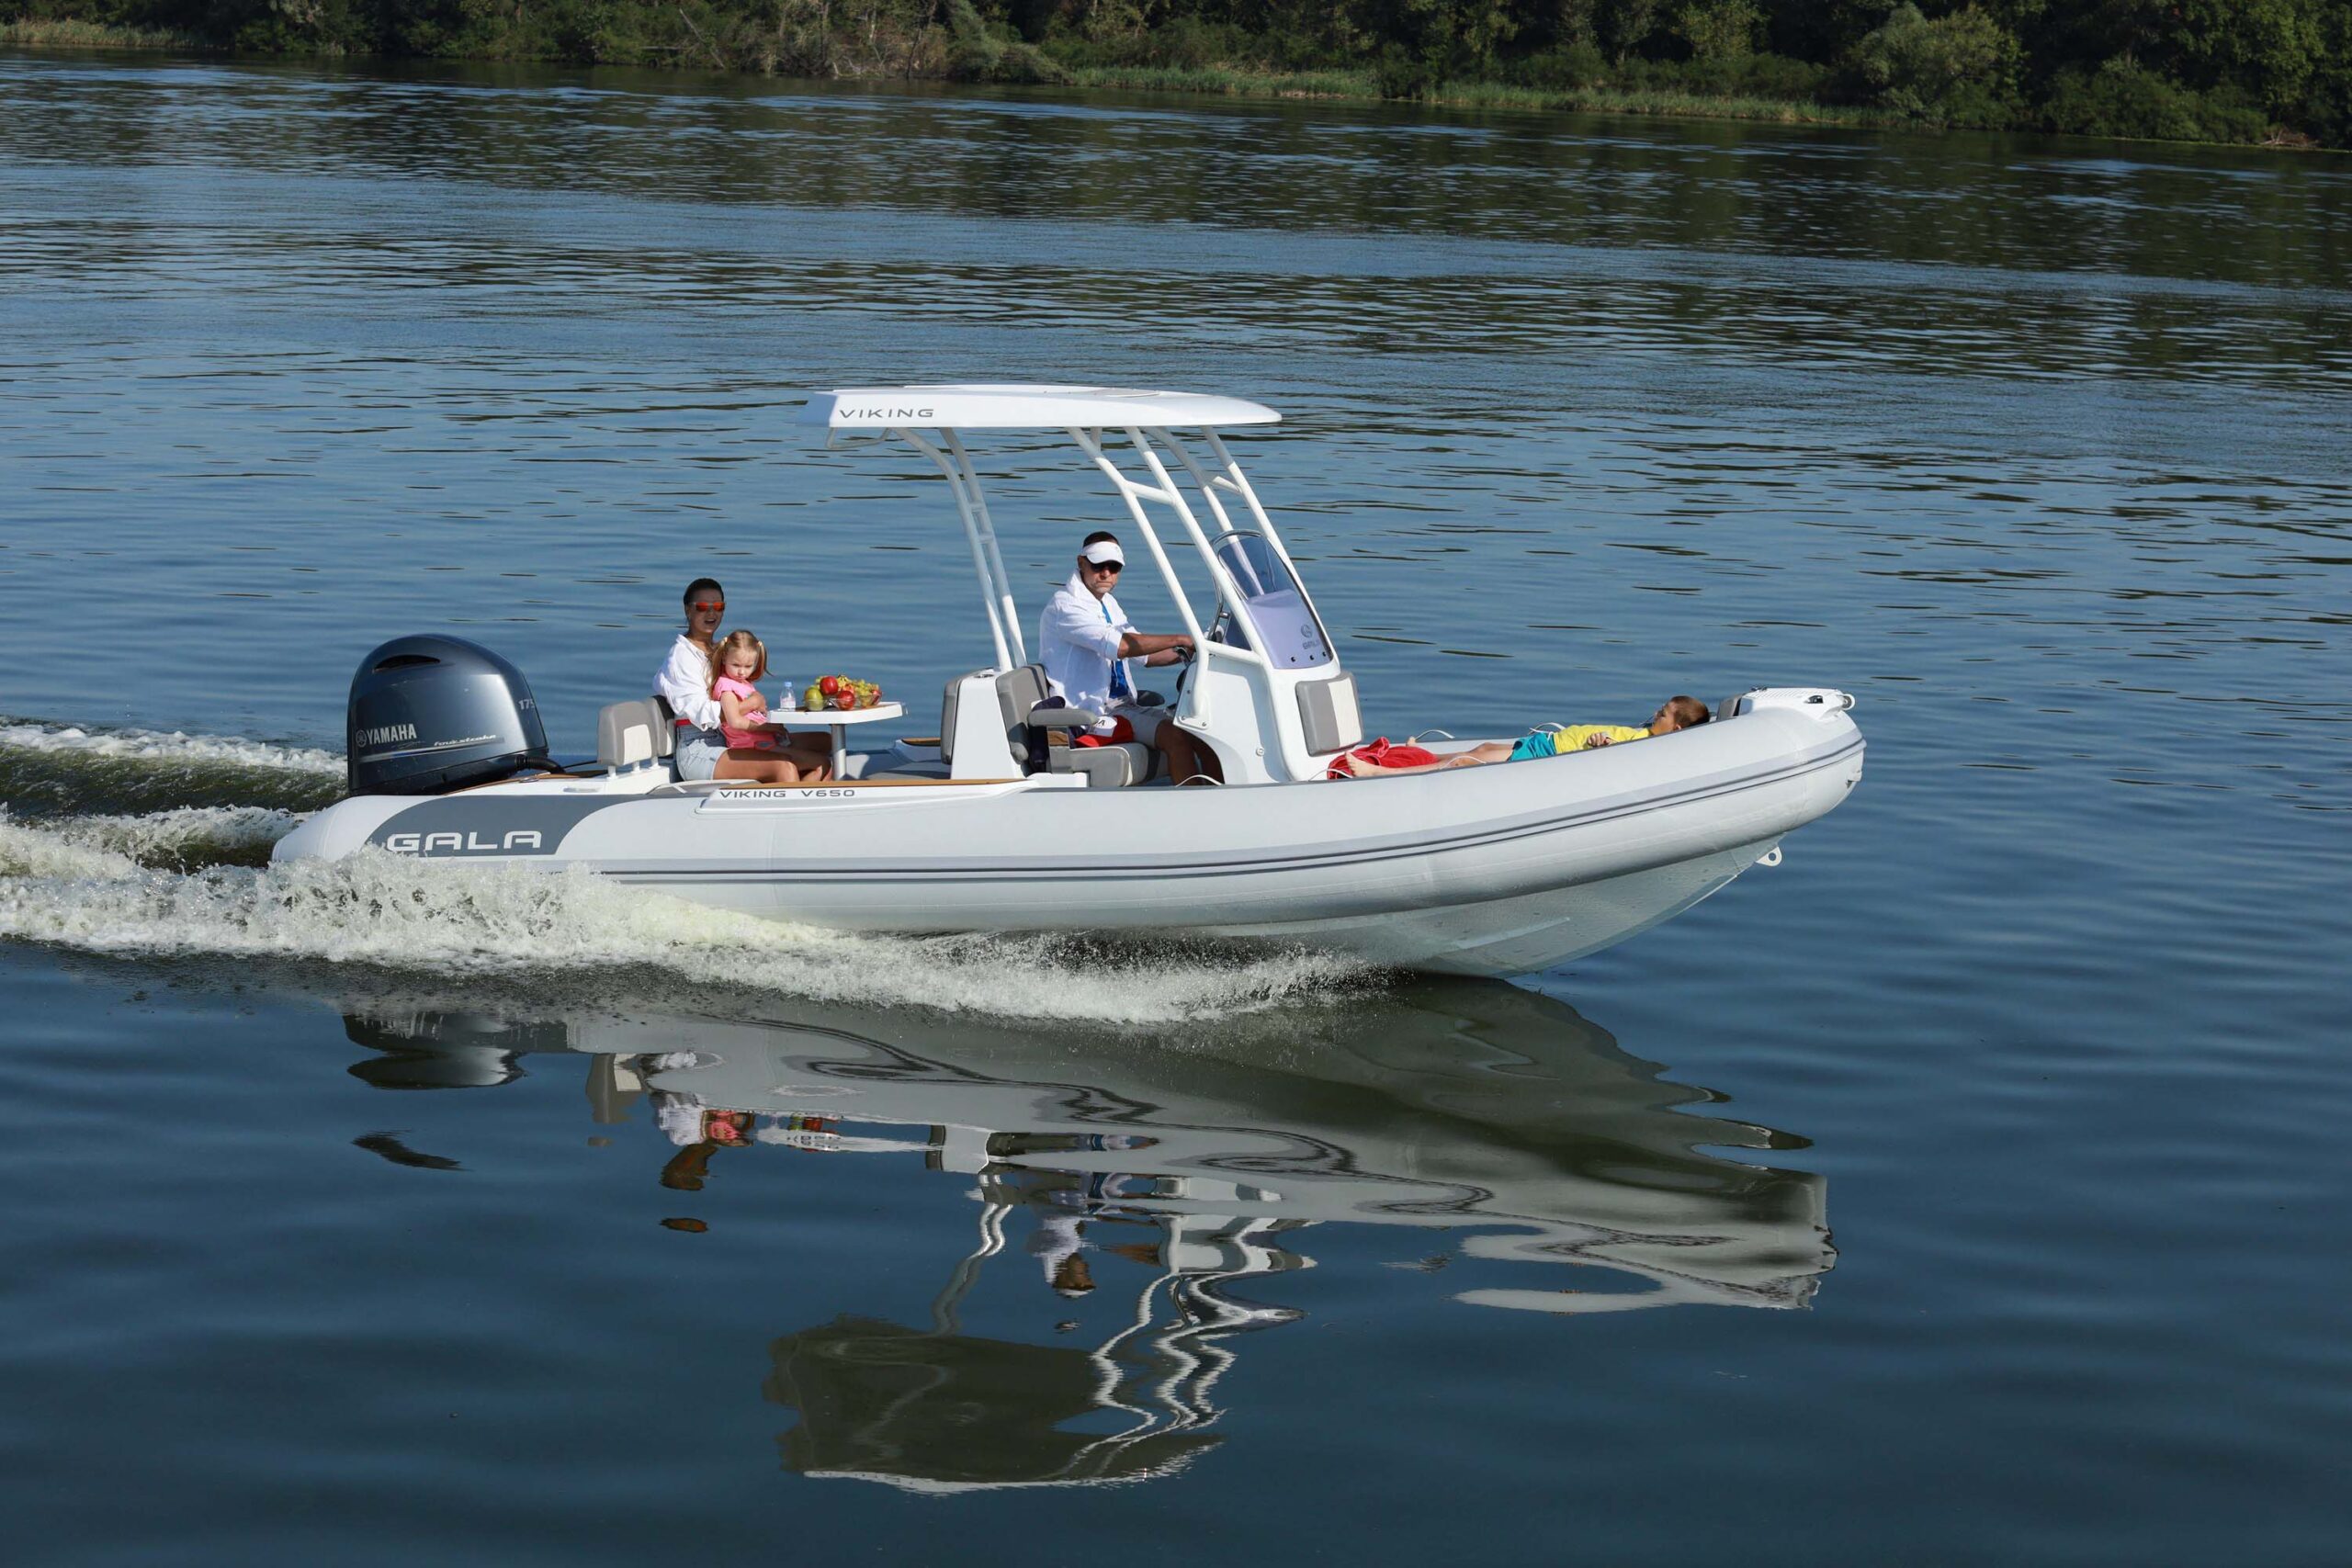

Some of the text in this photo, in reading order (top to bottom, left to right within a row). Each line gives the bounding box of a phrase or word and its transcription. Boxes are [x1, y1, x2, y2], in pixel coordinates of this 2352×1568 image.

[839, 409, 934, 419] VIKING
[367, 723, 417, 745] YAMAHA
[719, 789, 855, 798] VIKING V650
[386, 830, 543, 852] GALA
